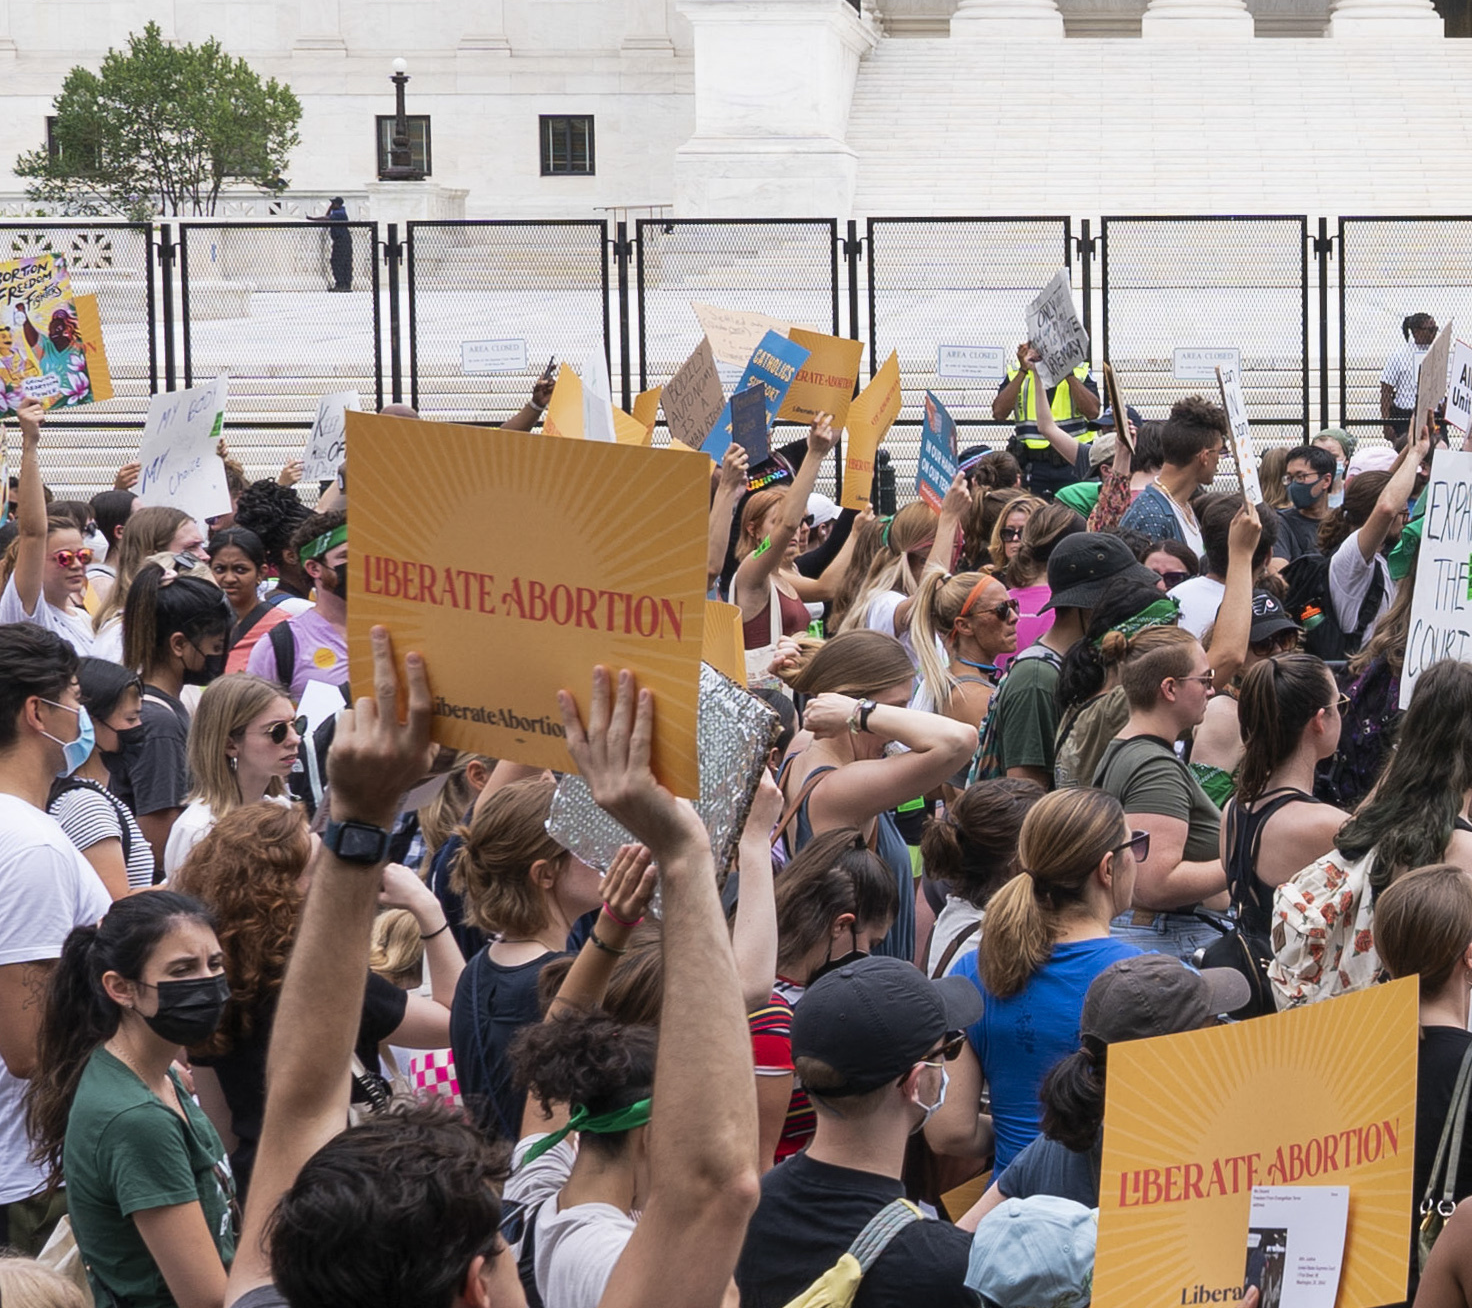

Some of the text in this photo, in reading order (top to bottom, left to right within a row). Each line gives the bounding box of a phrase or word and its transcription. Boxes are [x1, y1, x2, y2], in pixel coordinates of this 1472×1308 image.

[469, 343, 520, 353] AREA CLOSED
[753, 348, 796, 383] CATHOLICS
[946, 351, 998, 360] AREA CLOSED
[1181, 352, 1234, 360] AREA CLOSED
[668, 349, 704, 404] BODILY
[671, 366, 715, 426] AUTONOMY
[363, 554, 685, 642] LIBERATE ABORTION
[1434, 558, 1471, 615] THE
[1408, 618, 1471, 679] COURT
[1118, 1118, 1400, 1208] LIBERATE ABORTION
